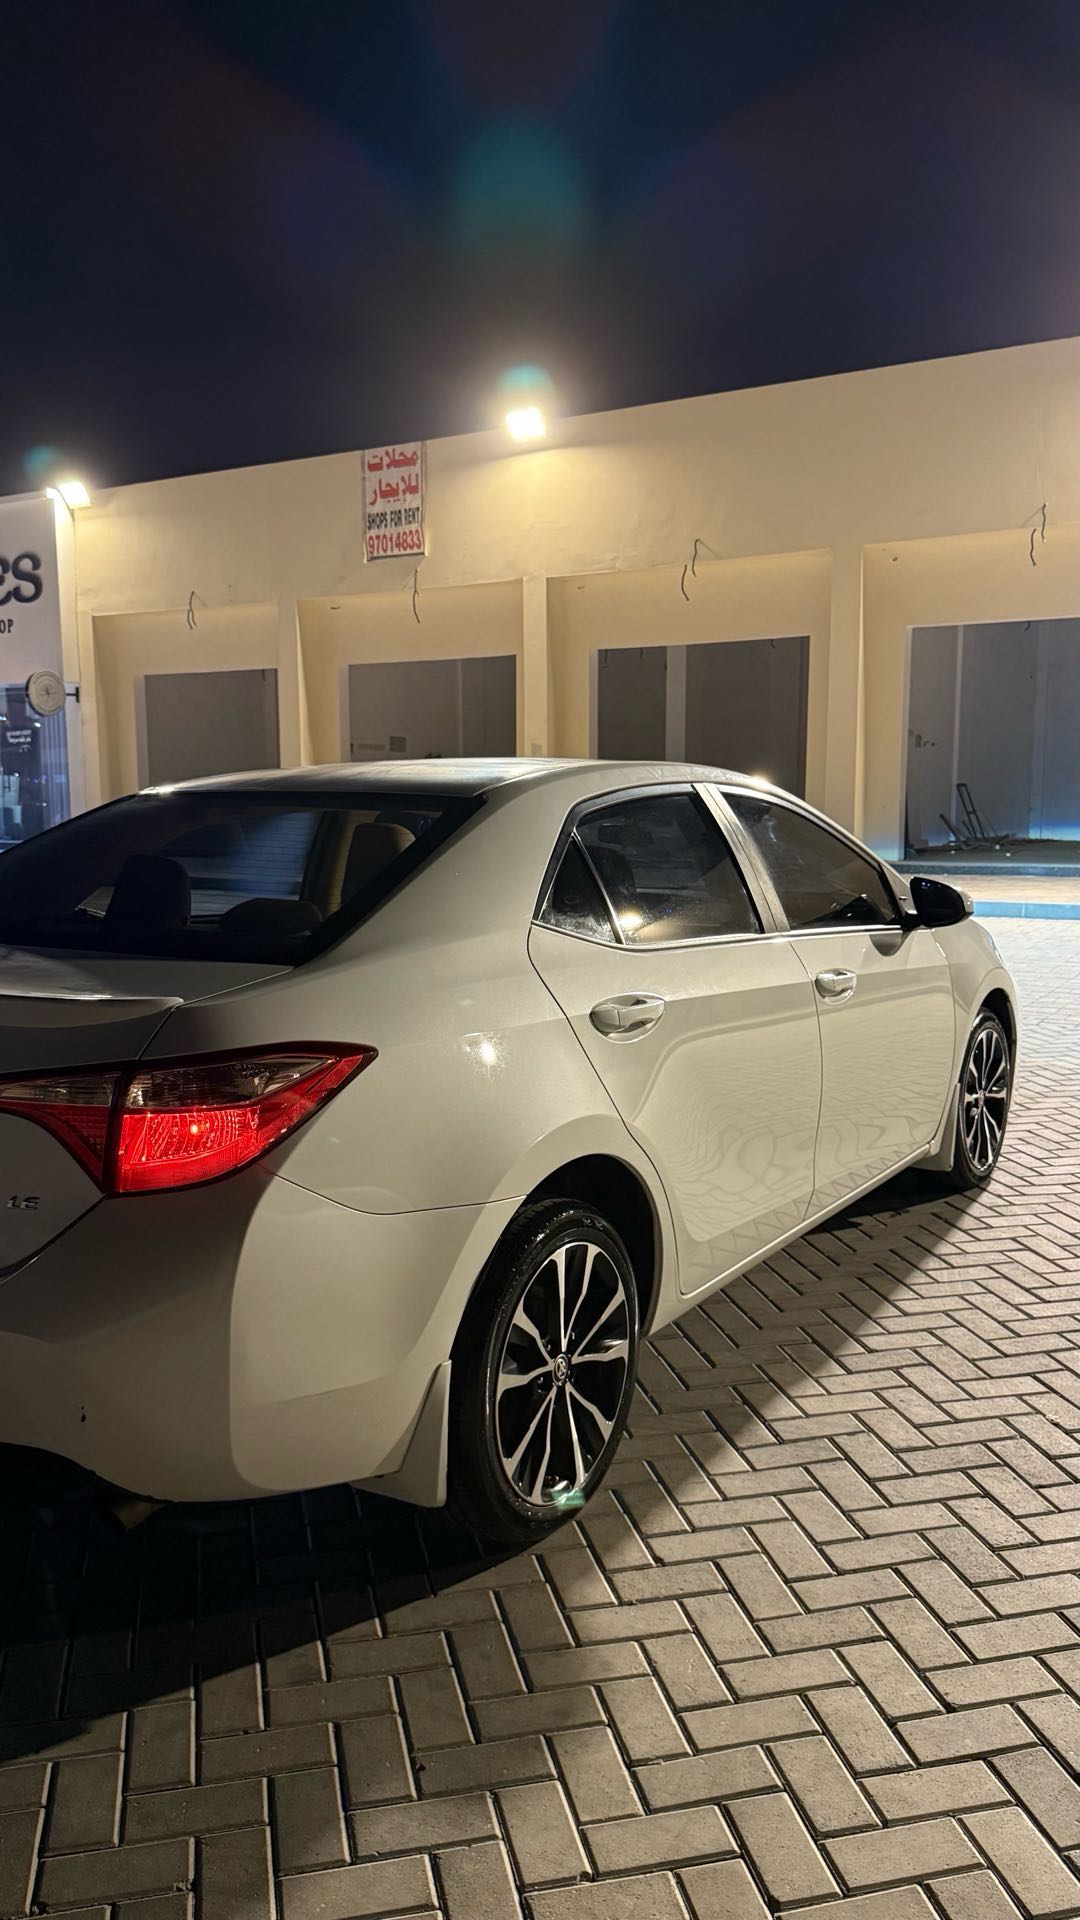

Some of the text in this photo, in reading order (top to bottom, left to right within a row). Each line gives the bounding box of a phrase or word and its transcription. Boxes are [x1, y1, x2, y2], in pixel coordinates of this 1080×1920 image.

[367, 448, 419, 472] محلات
[367, 507, 420, 531] SHOPS FOR RENT
[368, 529, 421, 555] 97014833
